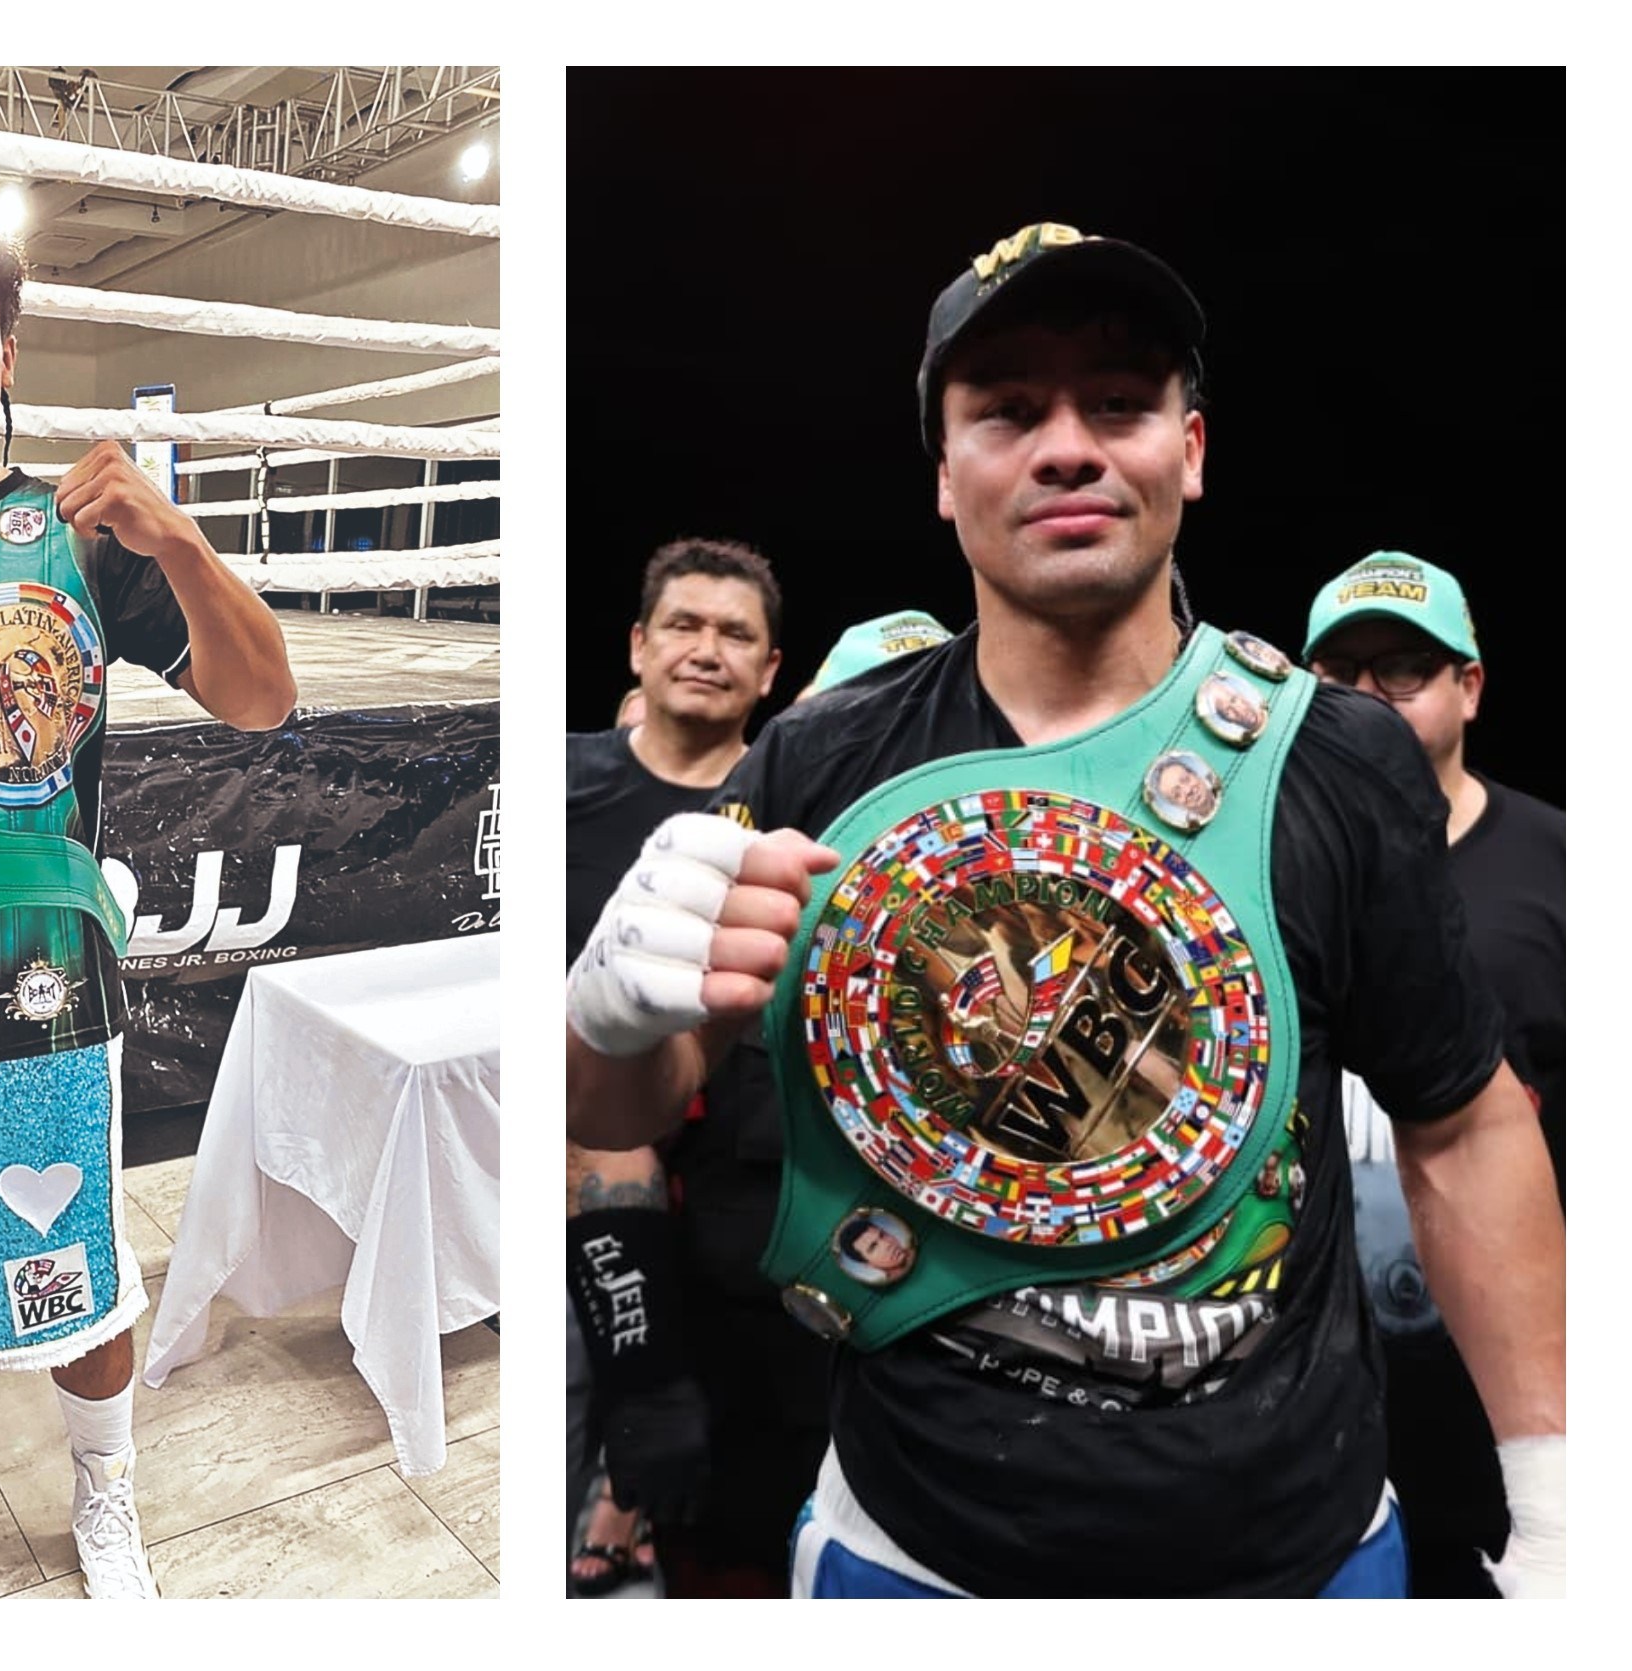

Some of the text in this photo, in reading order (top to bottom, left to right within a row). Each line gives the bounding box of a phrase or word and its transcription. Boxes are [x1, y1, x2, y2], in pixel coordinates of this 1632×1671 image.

[972, 221, 1105, 280] WB
[10, 510, 22, 536] WBC
[1336, 579, 1428, 605] TEAM
[0, 607, 58, 632] LATIN
[100, 844, 302, 957] JJ
[118, 945, 298, 971] NES JR. BOXING
[893, 876, 1116, 1128] WORLD CHAMPION
[995, 934, 1172, 1153] WBC
[18, 1289, 84, 1326] WBC
